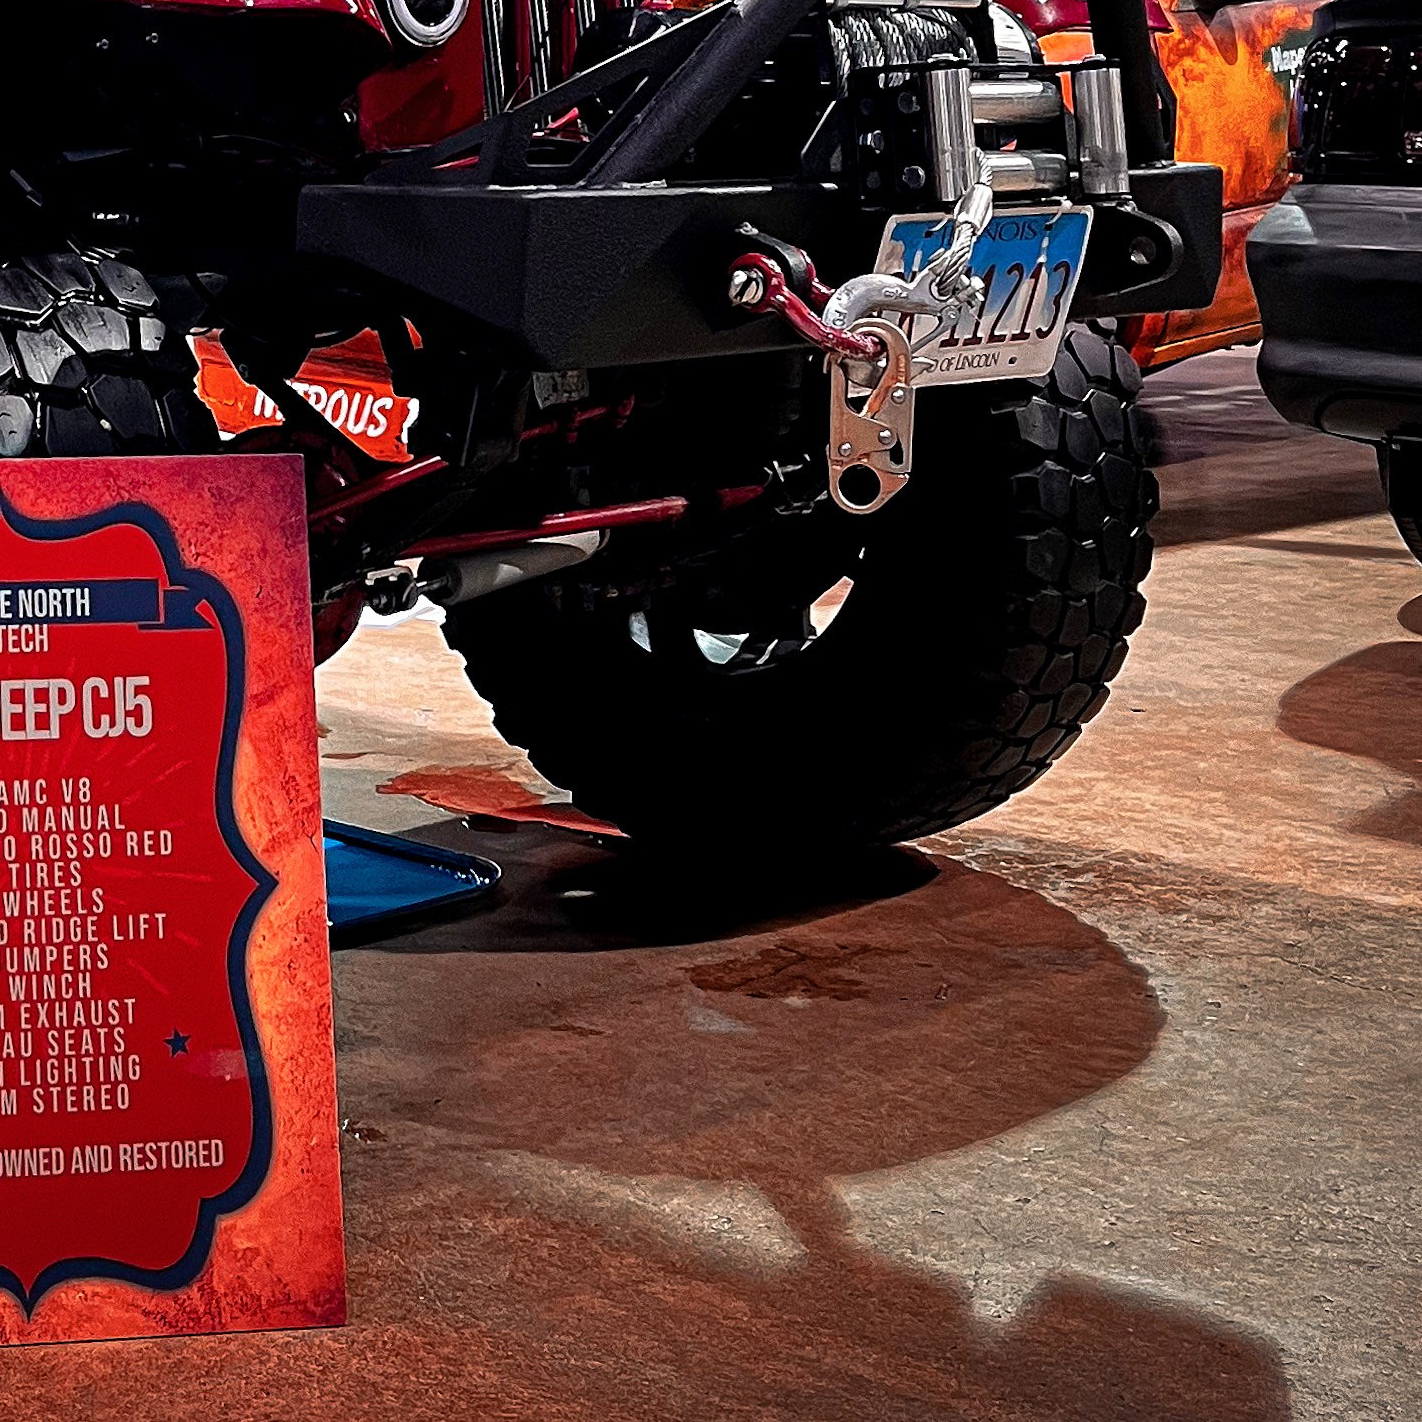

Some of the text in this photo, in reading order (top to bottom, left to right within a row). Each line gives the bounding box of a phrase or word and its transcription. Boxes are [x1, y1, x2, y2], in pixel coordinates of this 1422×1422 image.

[940, 220, 1037, 246] ILNOIS
[19, 588, 90, 618] NORTH
[83, 676, 152, 738] CJ5
[62, 778, 90, 803] V8
[23, 805, 125, 832] MANUAL
[32, 832, 110, 859] ROSSO
[127, 830, 171, 856] RED
[8, 861, 81, 888] TIRES
[3, 888, 103, 916] WHEELS
[24, 916, 98, 944] RIDGE
[113, 914, 166, 940] LIFT
[9, 972, 90, 1001] WINCH
[21, 999, 135, 1028] EXHAUST
[48, 1027, 124, 1055] SEATS
[21, 1055, 139, 1085] LIGHTING
[33, 1084, 128, 1113] STEREO
[72, 1145, 112, 1173] AND
[120, 1140, 223, 1171] RESTORED
